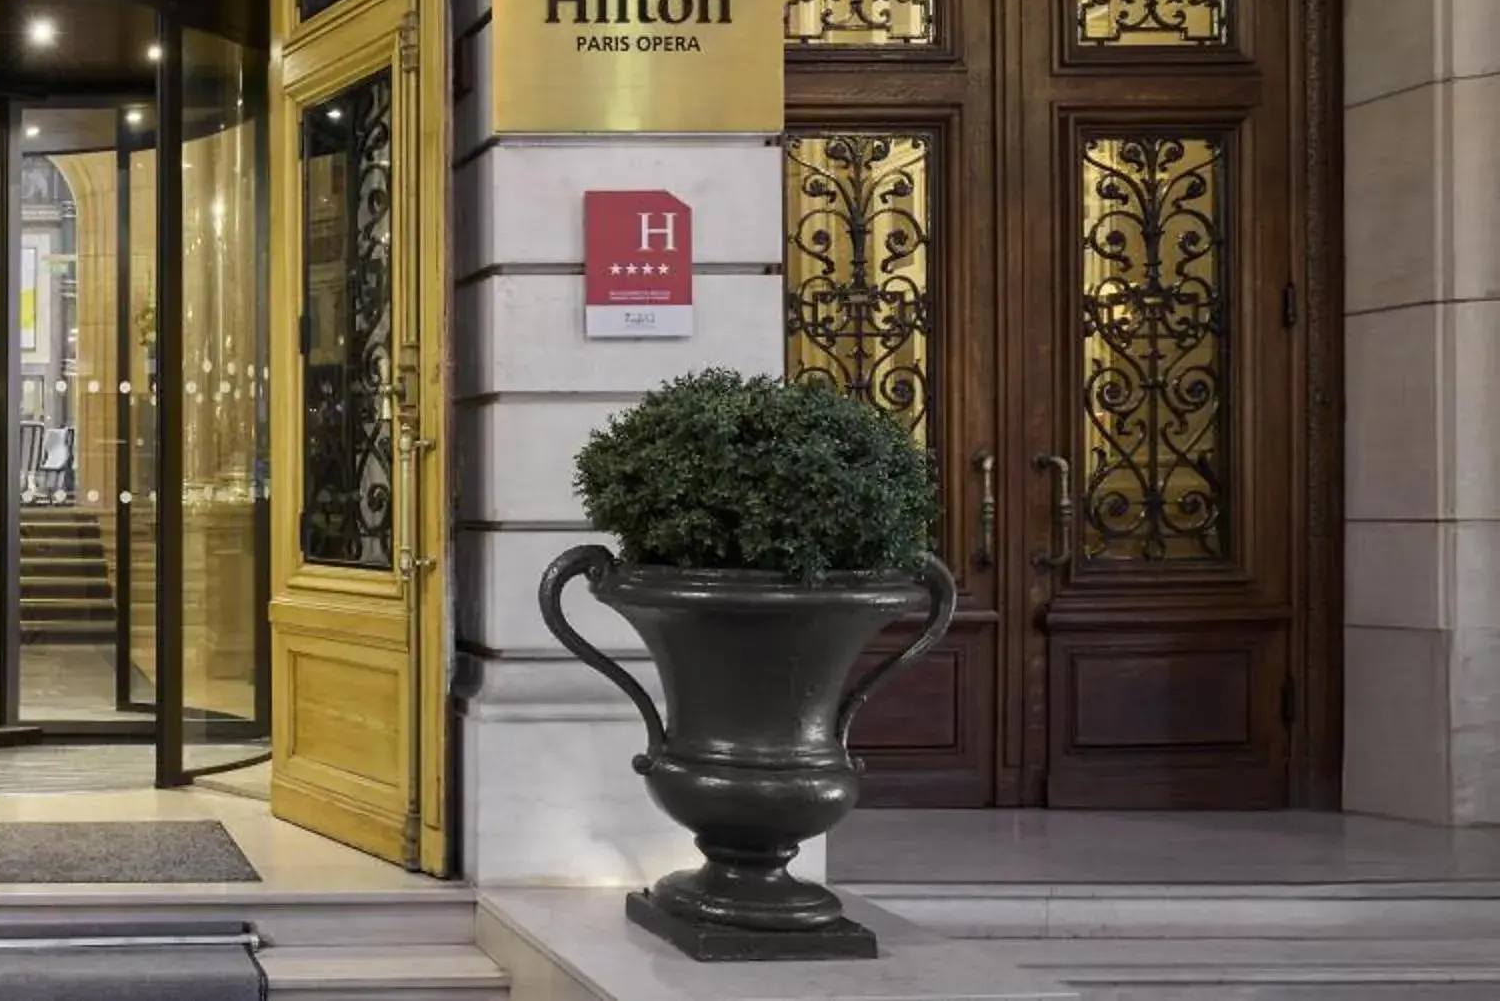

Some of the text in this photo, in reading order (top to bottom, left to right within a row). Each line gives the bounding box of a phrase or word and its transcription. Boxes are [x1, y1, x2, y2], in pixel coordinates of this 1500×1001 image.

[576, 36, 701, 52] PARIS OPERA
[635, 212, 678, 252] H
